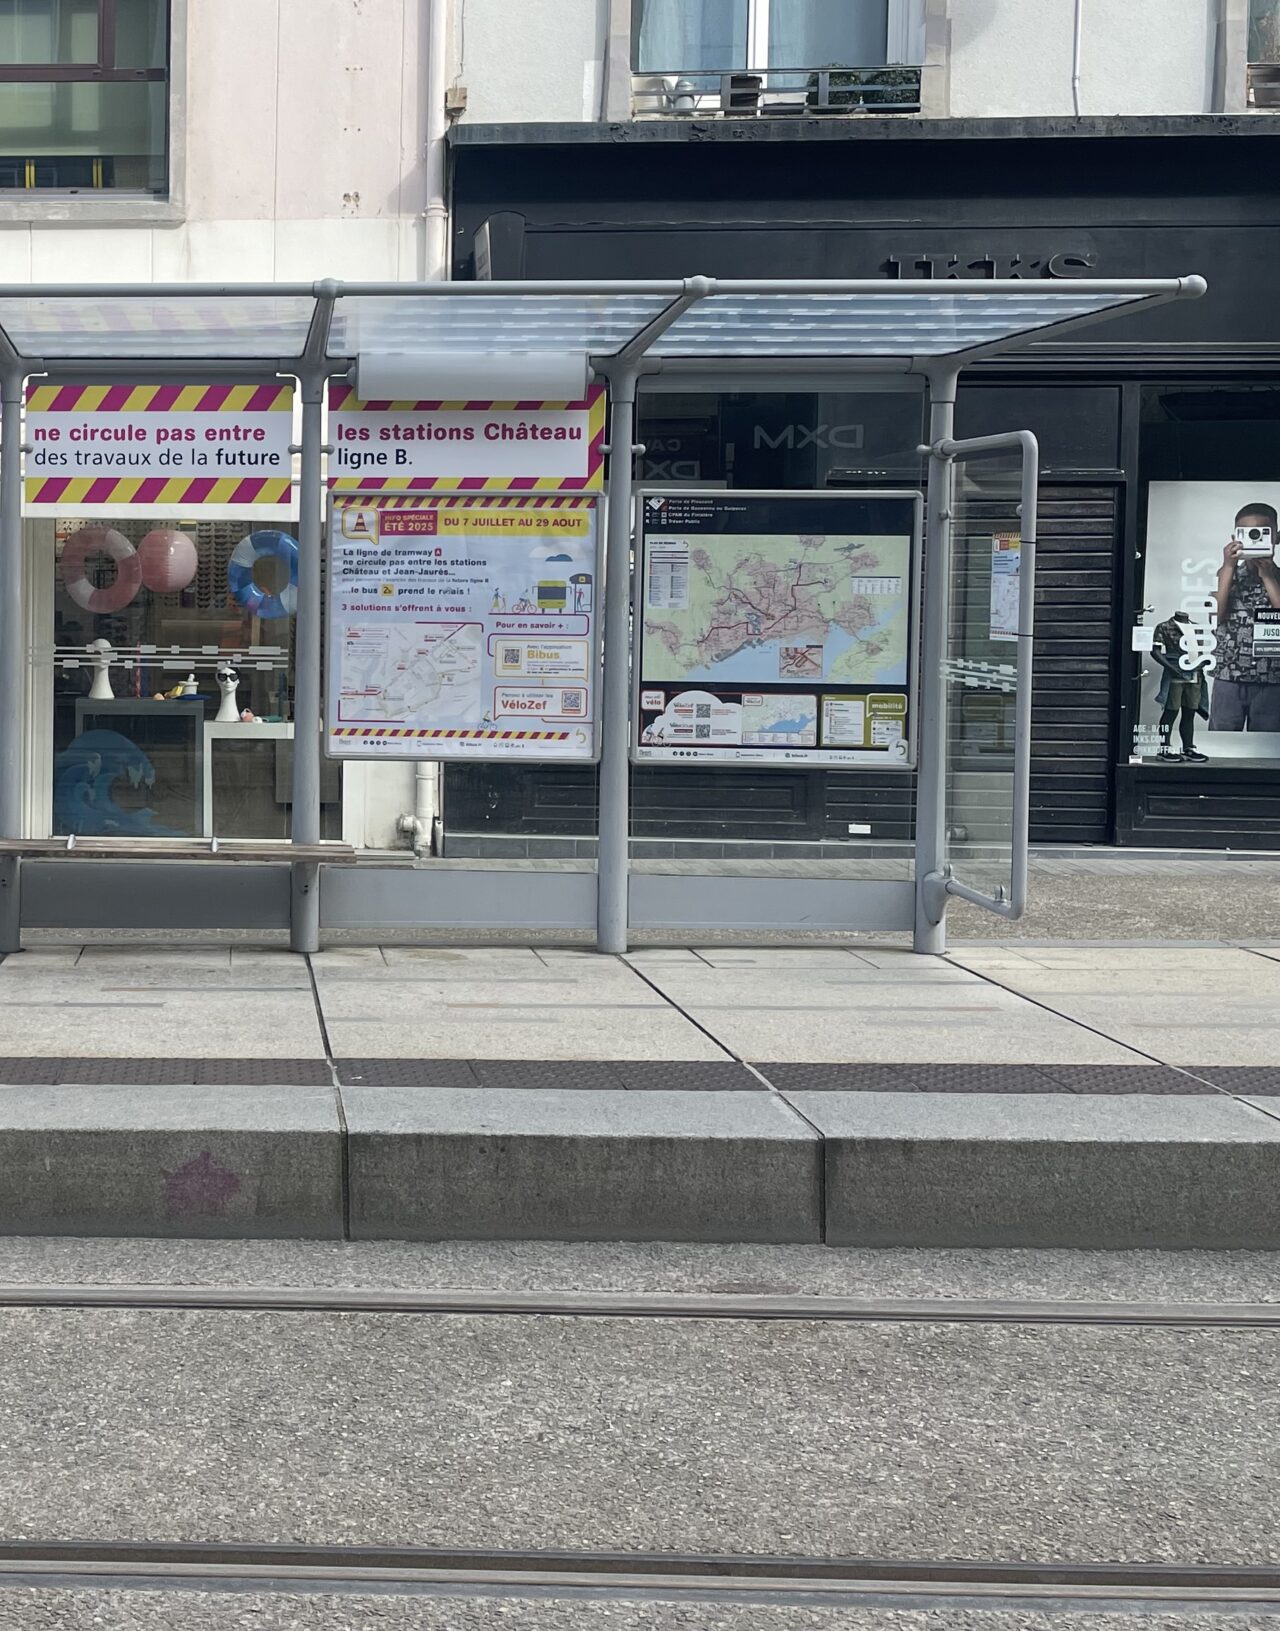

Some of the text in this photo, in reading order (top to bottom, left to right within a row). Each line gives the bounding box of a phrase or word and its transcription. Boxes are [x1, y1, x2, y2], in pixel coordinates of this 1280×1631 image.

[34, 424, 266, 445] ne circule pas entre
[337, 422, 582, 441] les stations Château
[34, 448, 281, 466] des travaux de la future
[337, 448, 413, 470] ligne B.
[402, 513, 434, 522] SPÉCIALE
[444, 518, 459, 526] DU
[463, 518, 468, 526] 7
[472, 518, 515, 527] JUILLET
[518, 518, 533, 527] AU
[536, 519, 549, 527] 29
[384, 521, 434, 532] ÉTÉ 2025
[356, 548, 379, 558] ligne
[395, 549, 433, 558] tramway
[450, 559, 487, 567] stations
[394, 604, 433, 612] s'offrent
[436, 604, 442, 612] à
[527, 649, 560, 659] Bibus
[501, 699, 547, 710] VéloZef
